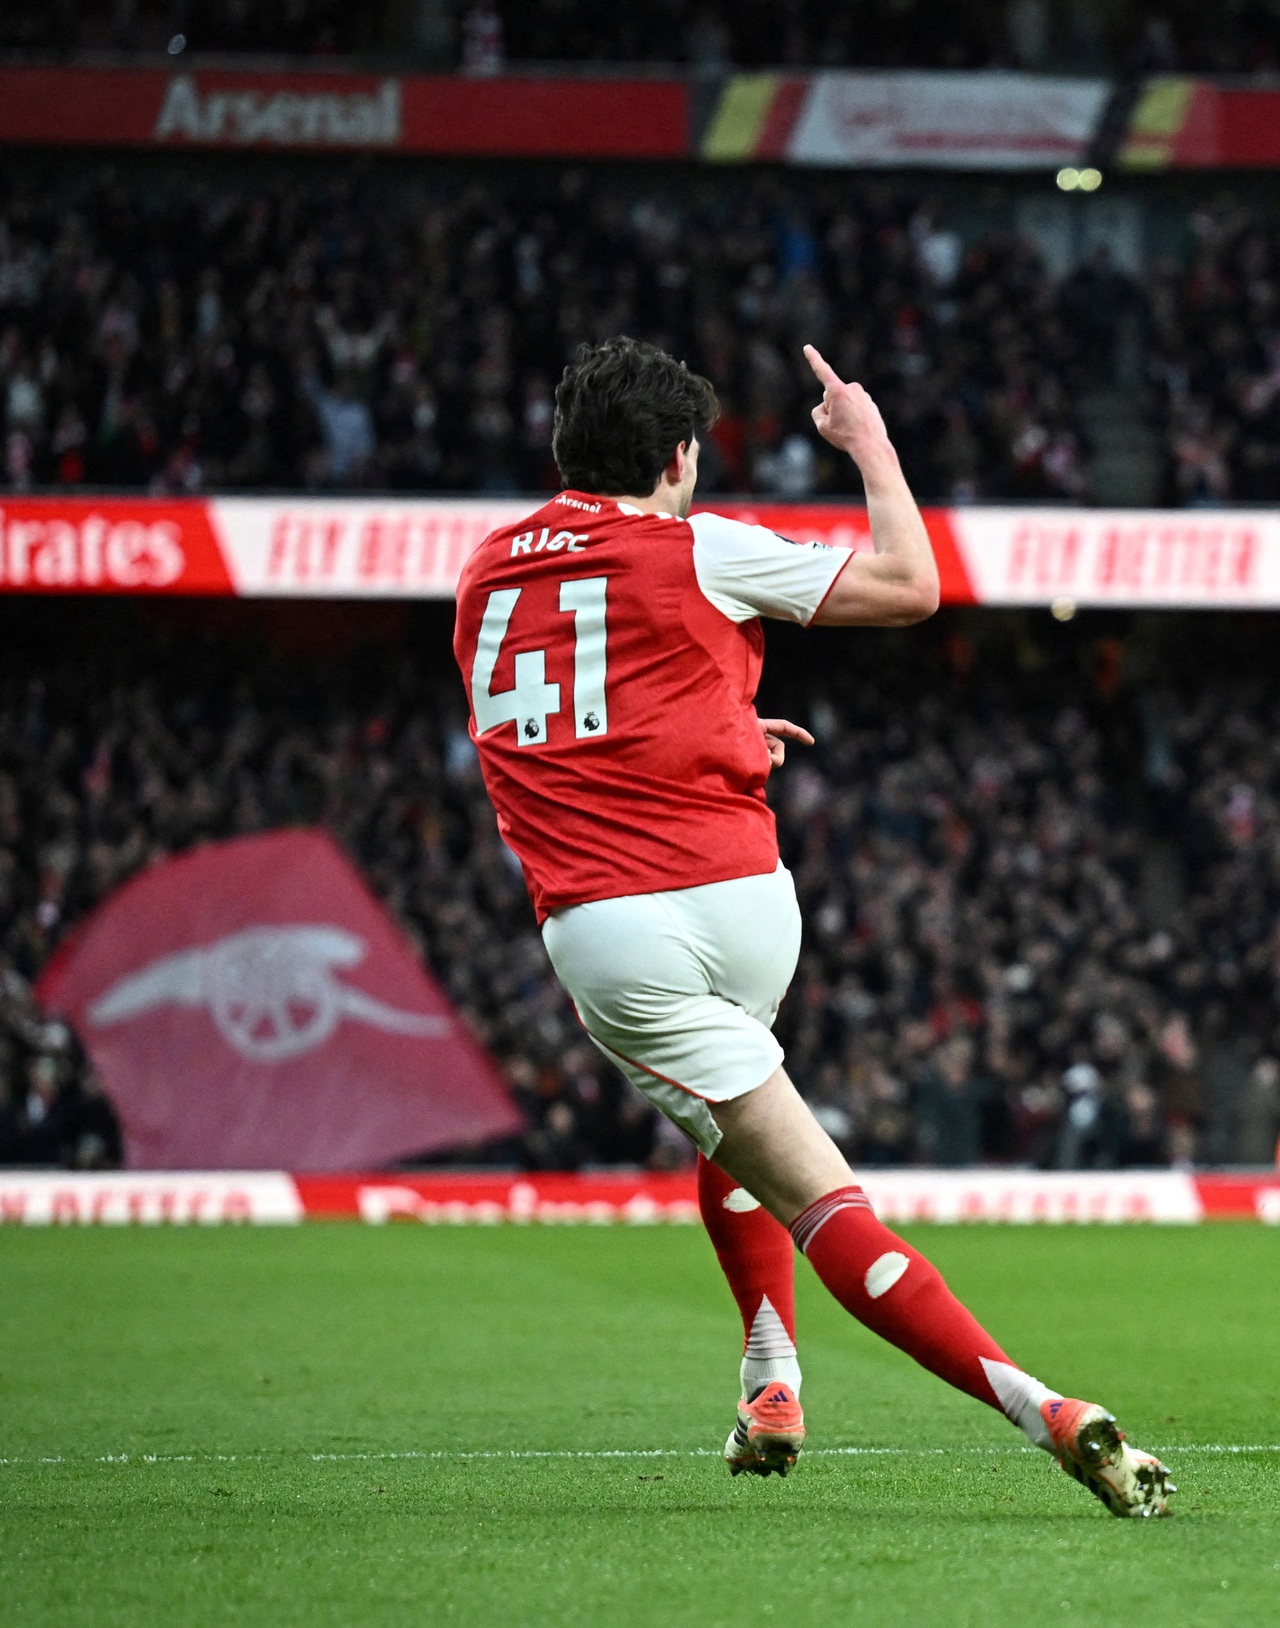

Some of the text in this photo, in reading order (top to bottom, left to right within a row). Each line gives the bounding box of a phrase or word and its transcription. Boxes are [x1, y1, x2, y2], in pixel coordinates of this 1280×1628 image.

[155, 75, 400, 143] Arsenal
[555, 495, 602, 514] Arsenal
[1006, 522, 1258, 588] FLY BETTER
[471, 577, 608, 747] 41
